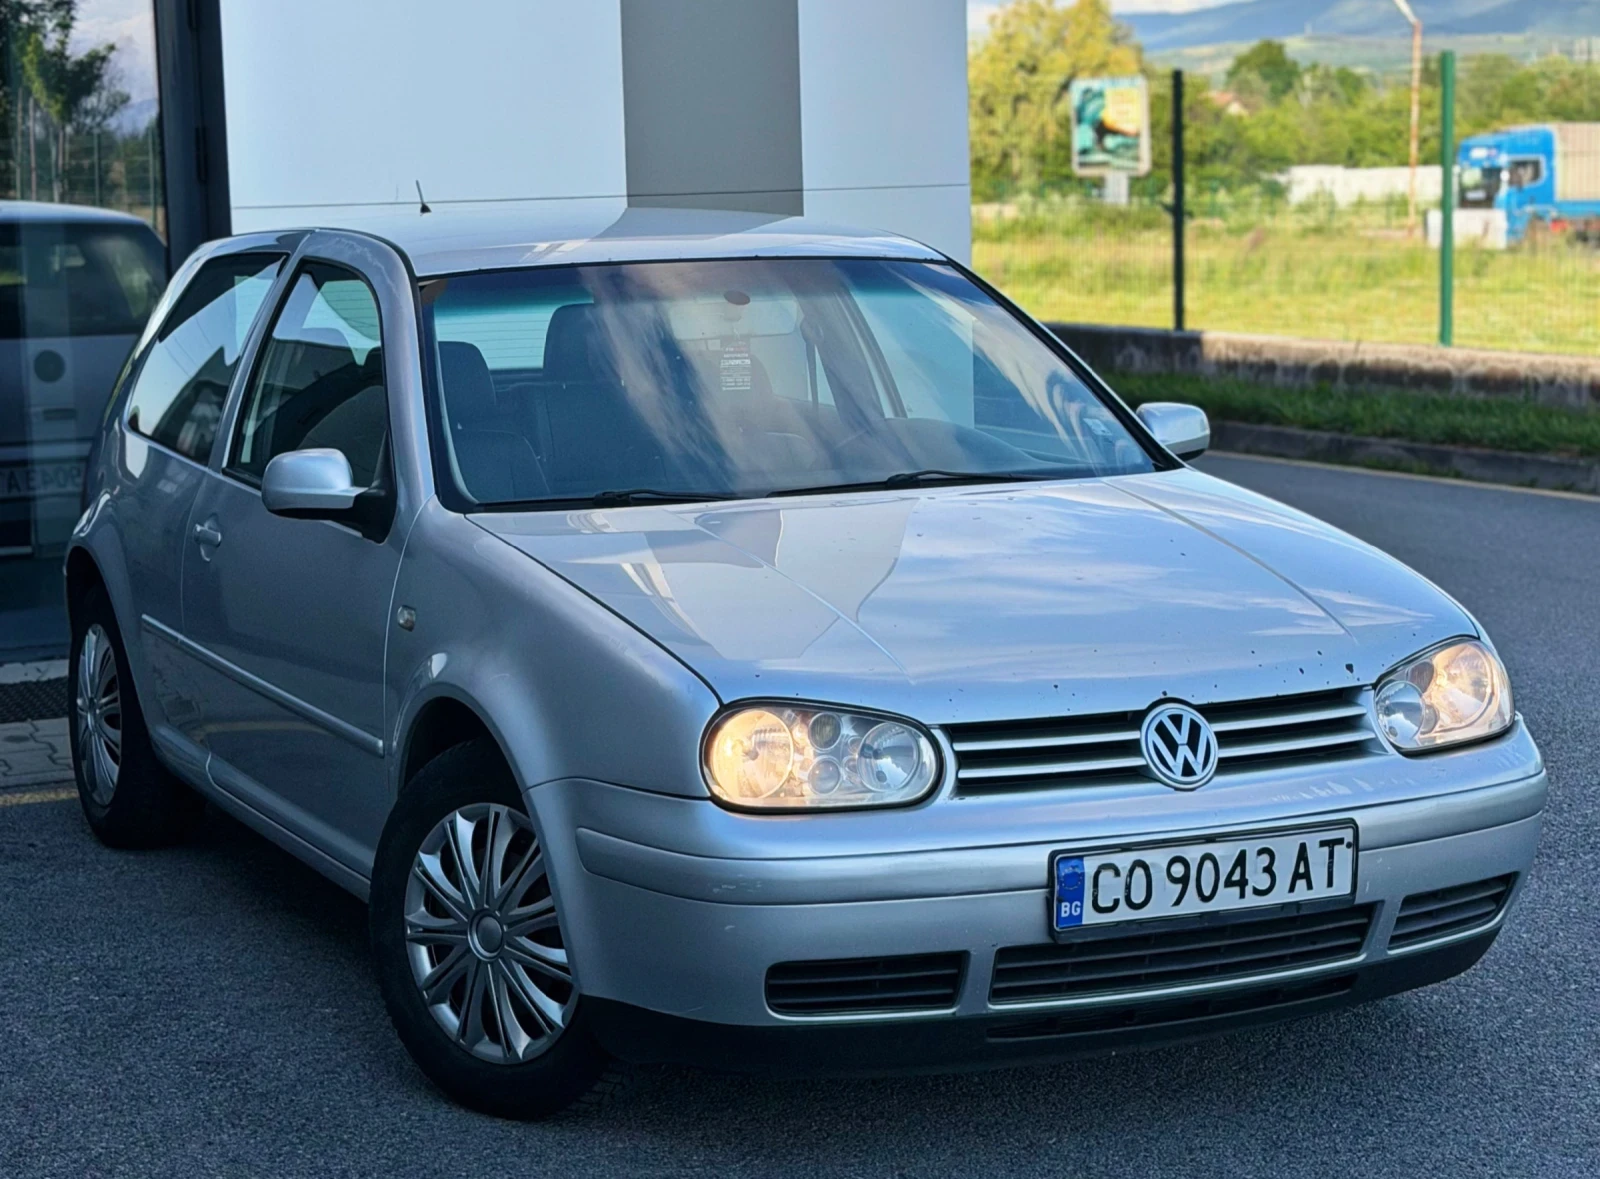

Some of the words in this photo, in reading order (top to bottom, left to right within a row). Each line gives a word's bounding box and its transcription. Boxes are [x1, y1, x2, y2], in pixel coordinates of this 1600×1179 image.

[1146, 706, 1214, 784] VW
[1061, 901, 1082, 917] BG
[1091, 859, 1151, 914] CO
[1166, 846, 1277, 907] 9043
[1287, 837, 1345, 894] AT
